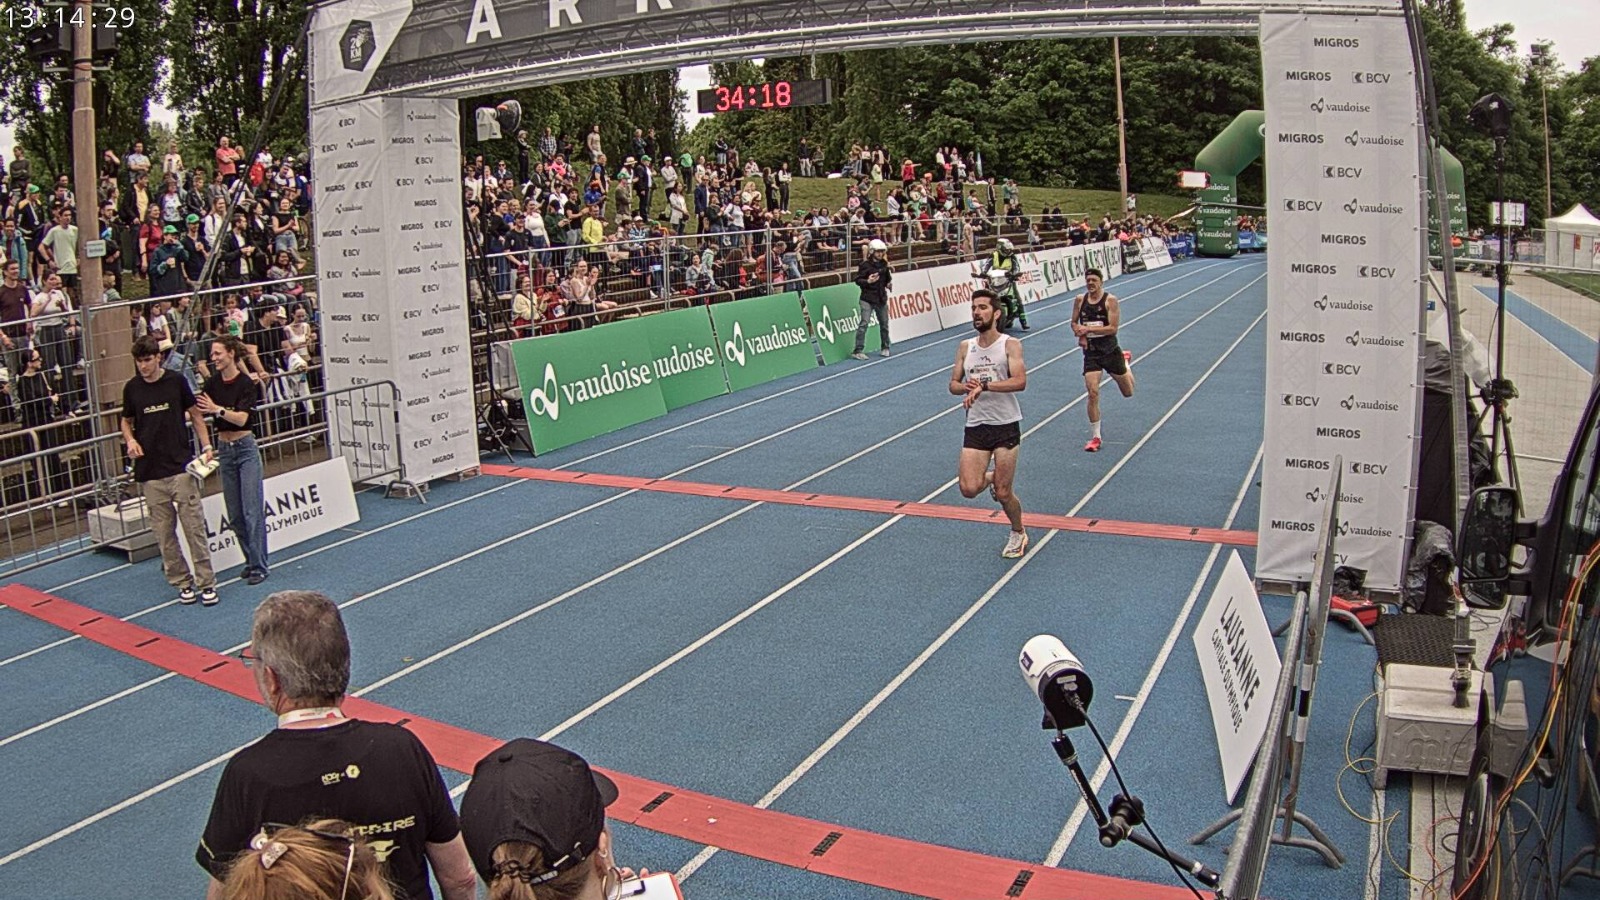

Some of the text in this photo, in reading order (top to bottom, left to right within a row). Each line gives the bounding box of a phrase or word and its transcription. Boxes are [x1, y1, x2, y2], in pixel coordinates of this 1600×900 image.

[1314, 38, 1359, 47] MIGROS
[1286, 71, 1331, 81] MIGROS
[1366, 74, 1390, 83] BCV
[715, 81, 791, 111] 34:18
[1326, 102, 1370, 112] vaudoise
[344, 118, 356, 126] BCV
[1279, 133, 1324, 143] MIGROS
[1360, 136, 1404, 146] vaudoise
[326, 143, 338, 152] BCV
[337, 161, 358, 170] MIGROS
[1338, 168, 1362, 178] BCV
[360, 180, 373, 189] BCV
[402, 178, 415, 186] BCV
[325, 184, 345, 193] MIGROS
[414, 199, 437, 207] MIGROS
[1298, 201, 1322, 211] BCV
[1359, 204, 1403, 214] vaudoise
[401, 223, 424, 231] MIGROS
[440, 220, 452, 228] BCV
[1321, 234, 1366, 245] MIGROS
[348, 248, 360, 256] BCV
[398, 266, 421, 275] MIGROS
[1291, 264, 1337, 274] MIGROS
[1371, 267, 1396, 278] BCV
[427, 284, 440, 292] BCV
[888, 290, 932, 319] MIGROS
[1330, 300, 1373, 311] vaudoise
[367, 314, 380, 322] BCV
[410, 310, 422, 318] BCV
[422, 327, 444, 336] MIGROS
[745, 324, 807, 356] vaudoise
[1280, 332, 1325, 343] MIGROS
[1361, 336, 1404, 347] vaudoise
[447, 345, 459, 354] BCV
[408, 351, 431, 360] MIGROS
[1336, 364, 1361, 375] BCV
[561, 361, 652, 405] vaudoise
[407, 396, 430, 407] MIGROS
[1296, 396, 1320, 406] BCV
[1356, 400, 1399, 411] vaudoise
[437, 412, 449, 421] BCV
[1316, 427, 1360, 439] MIGROS
[419, 439, 432, 448] BCV
[432, 453, 454, 464] MIGROS
[1286, 458, 1330, 470] MIGROS
[1363, 464, 1387, 475] BCV
[1321, 493, 1364, 504] vdoise
[204, 483, 321, 539] LAANNE
[1271, 520, 1315, 532] MIGROS
[1350, 526, 1392, 537] vaudoise
[1220, 596, 1260, 712] LAUSANNE
[1223, 669, 1243, 734] OLYMPIQUE
